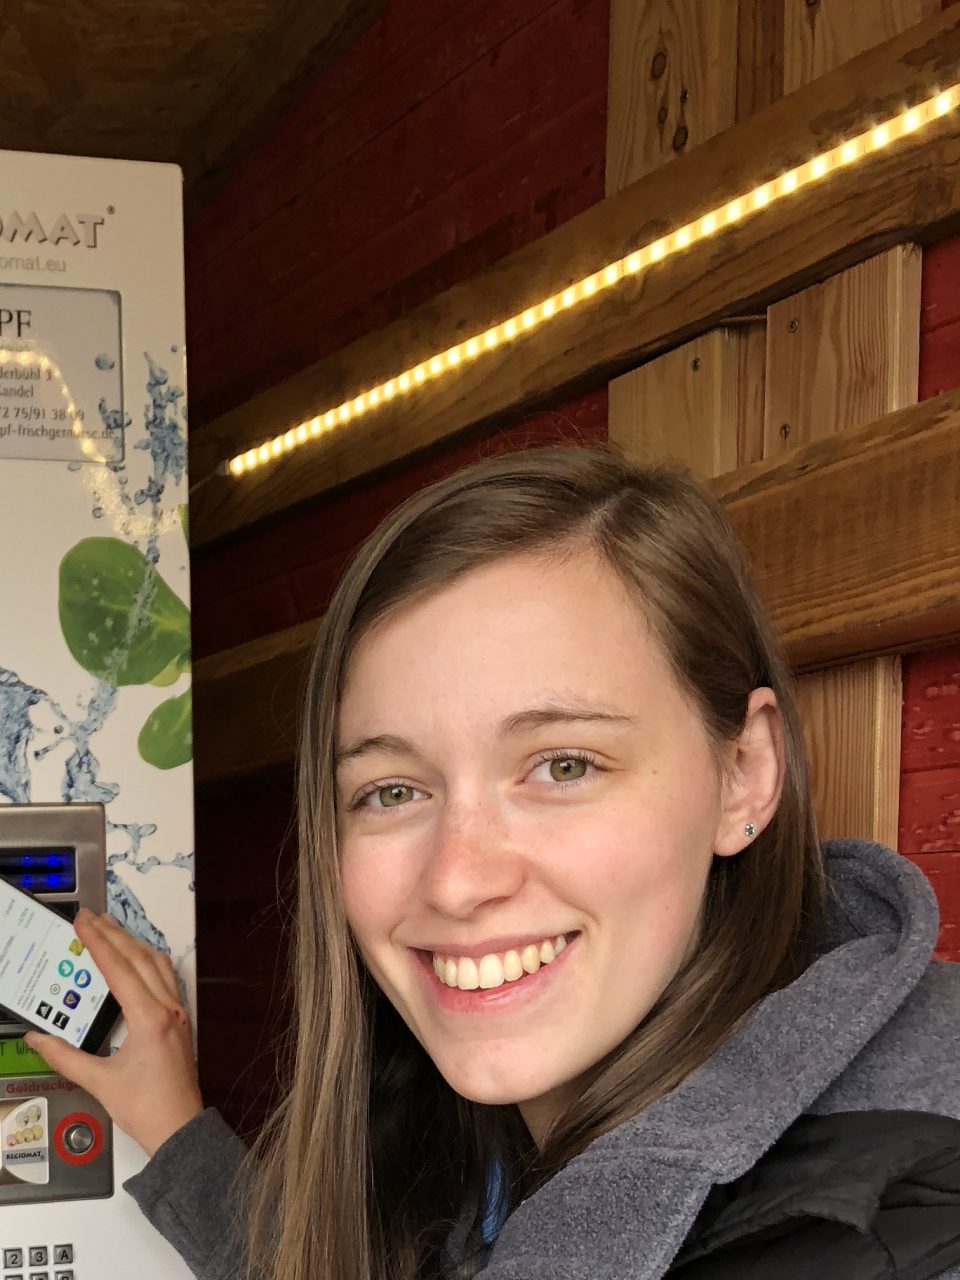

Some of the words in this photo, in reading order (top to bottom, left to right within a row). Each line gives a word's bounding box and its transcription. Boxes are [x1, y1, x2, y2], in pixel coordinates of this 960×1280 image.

[12, 1254, 18, 1265] 2
[37, 1252, 43, 1262] 3
[61, 1250, 69, 1260] A
